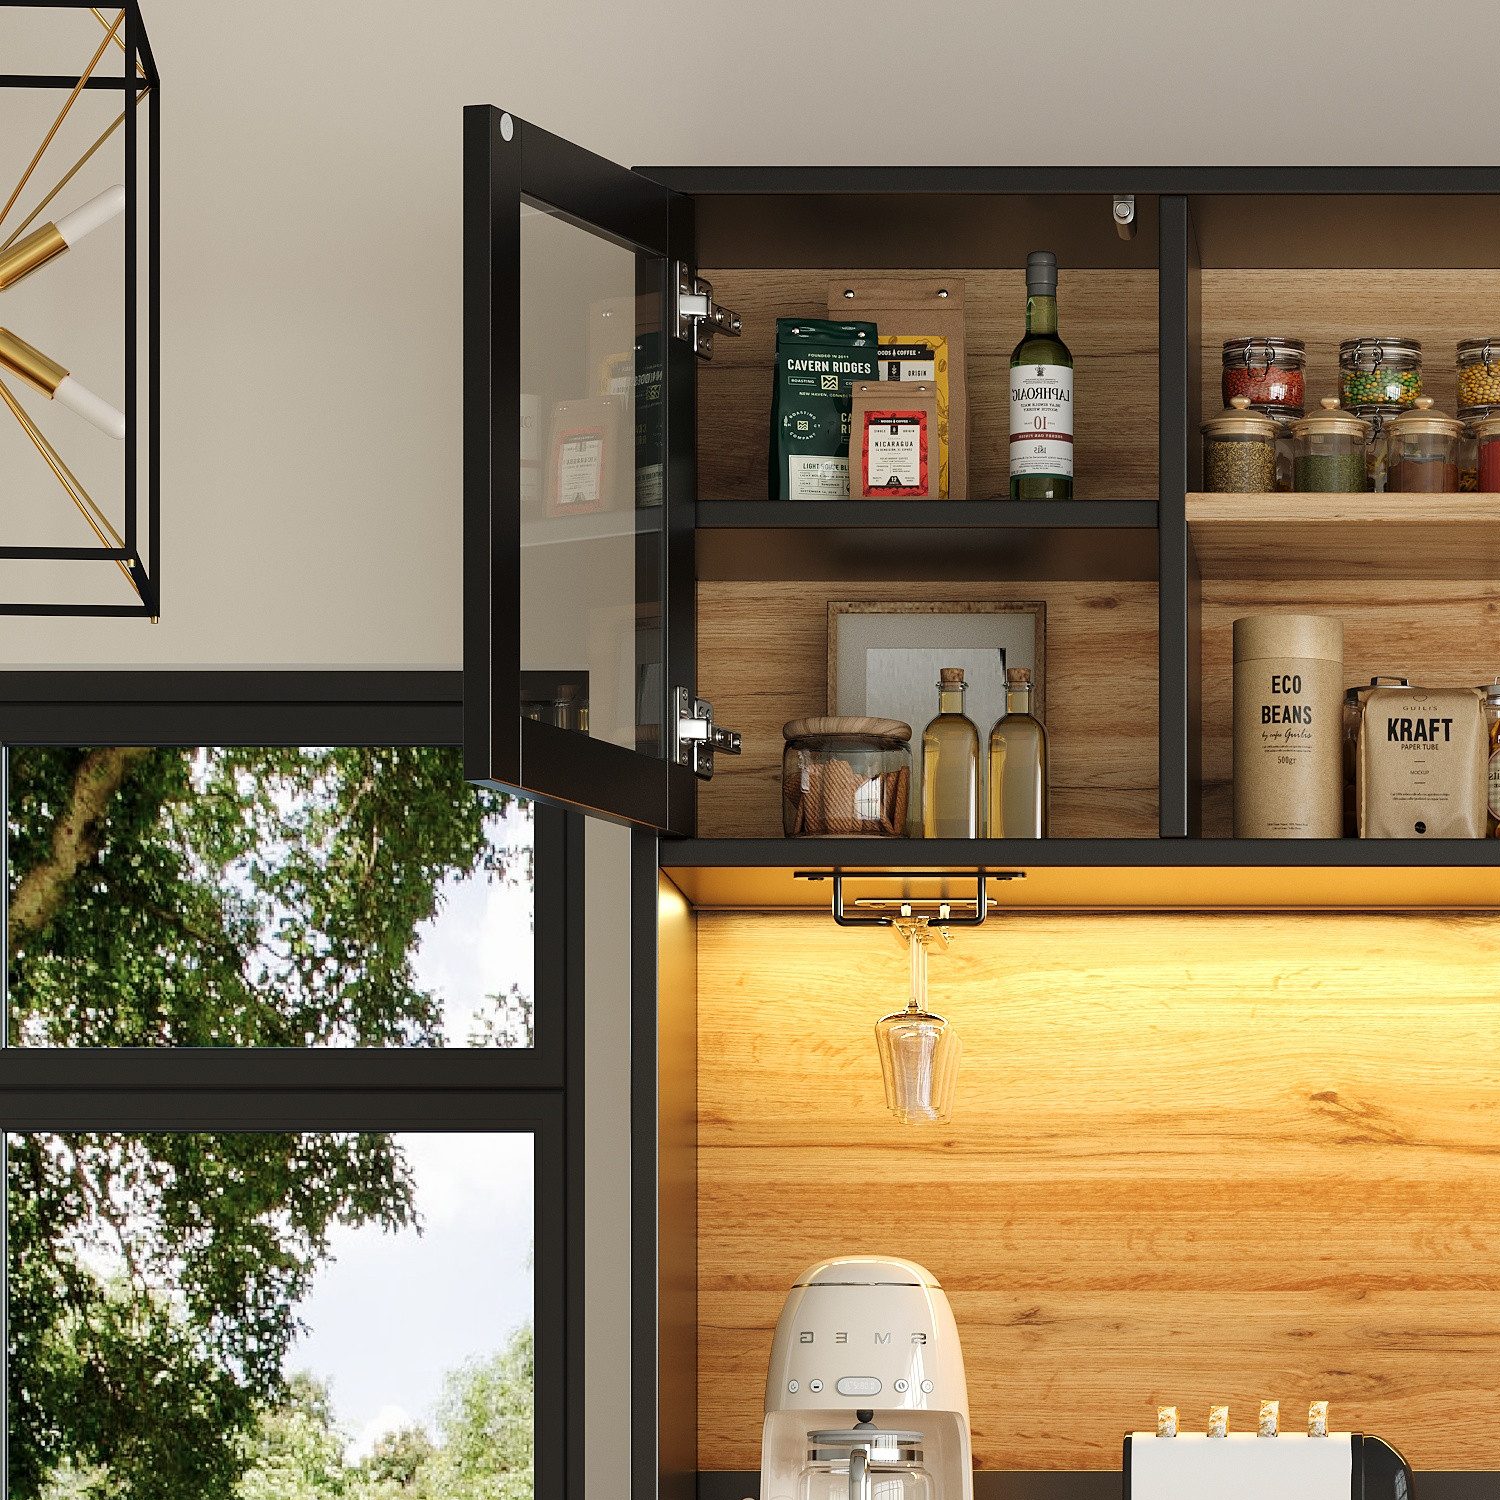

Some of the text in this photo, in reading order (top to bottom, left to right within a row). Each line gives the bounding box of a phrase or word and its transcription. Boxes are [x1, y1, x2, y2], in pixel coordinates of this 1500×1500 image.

[788, 359, 871, 374] CAVERN RIDGES
[1272, 675, 1301, 694] ECO
[1262, 705, 1312, 724] BEANS
[1388, 718, 1453, 741] KRAFT
[1278, 756, 1296, 765] 500gr
